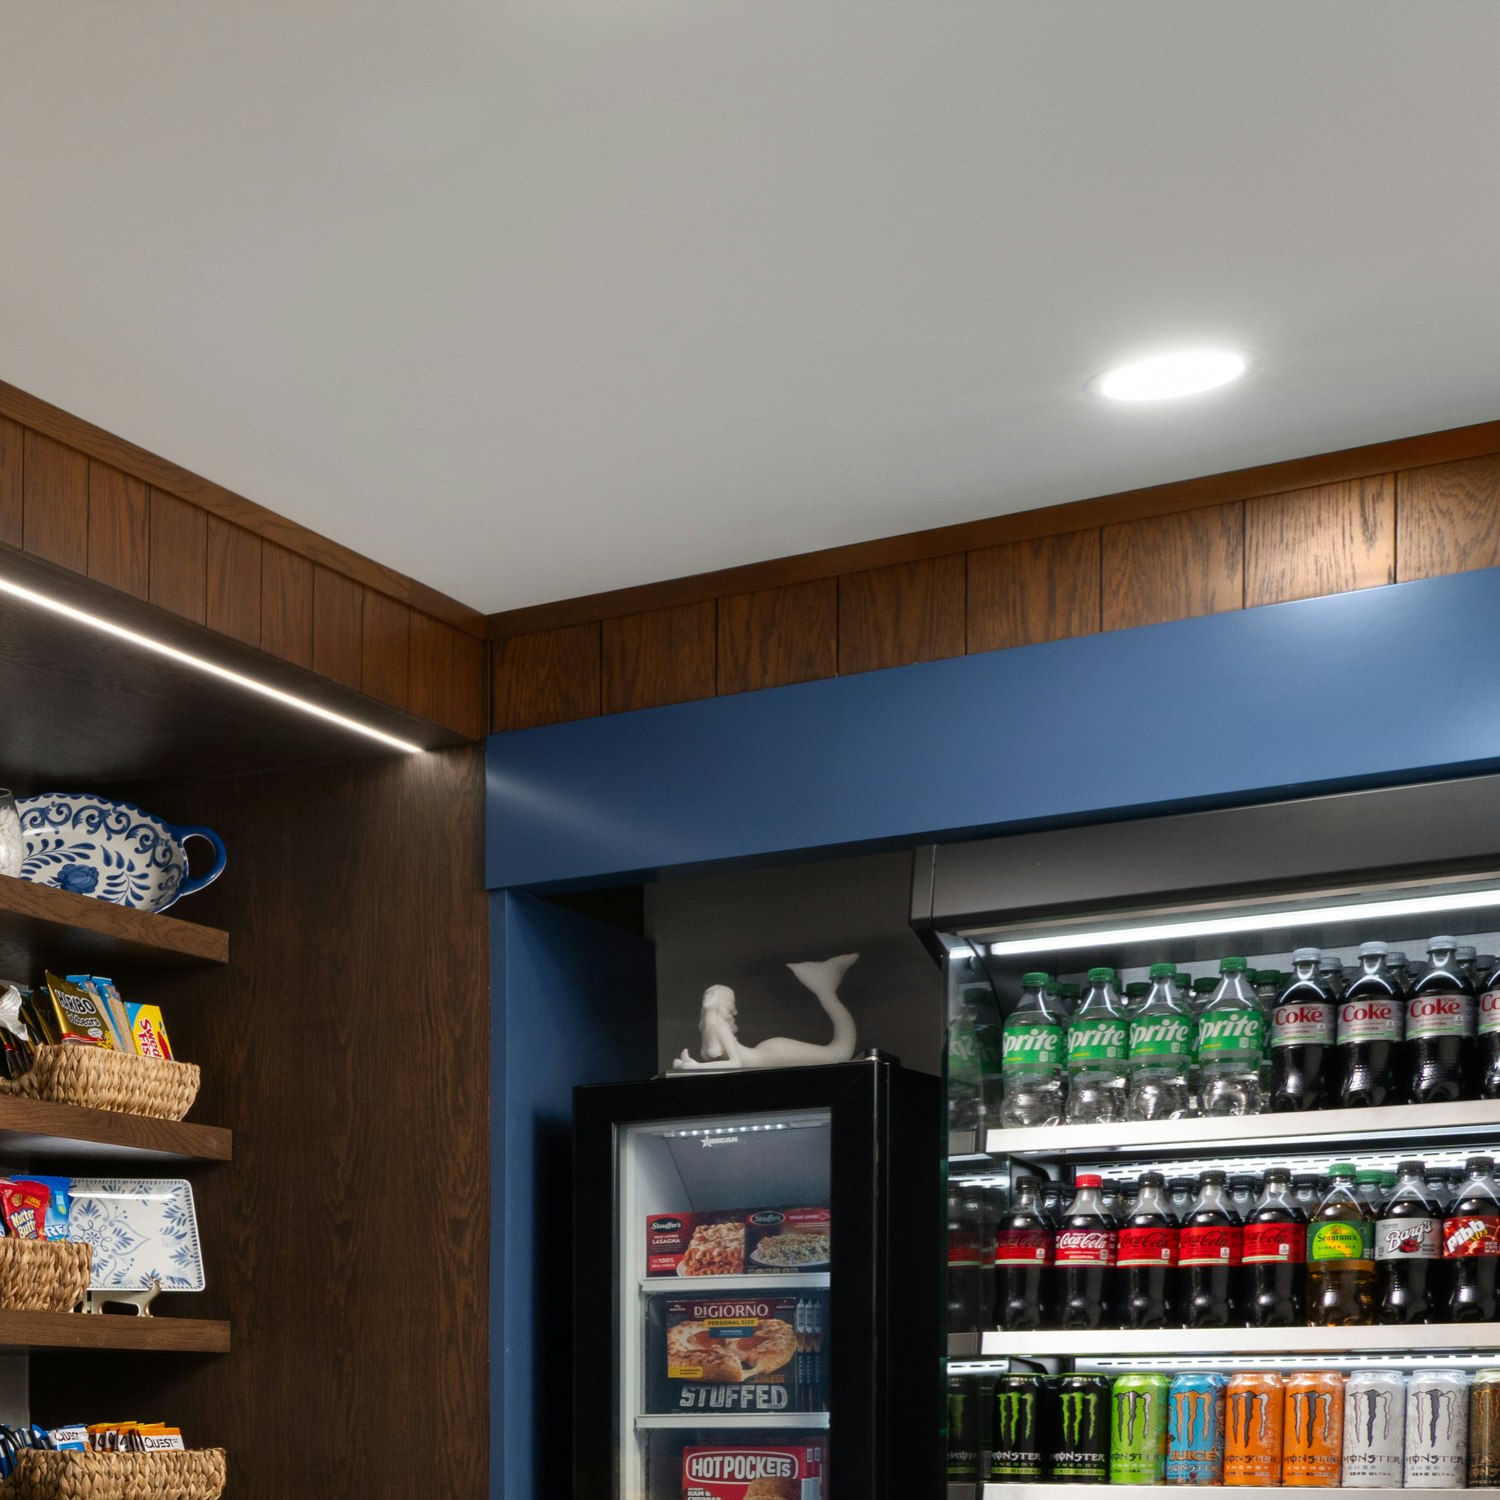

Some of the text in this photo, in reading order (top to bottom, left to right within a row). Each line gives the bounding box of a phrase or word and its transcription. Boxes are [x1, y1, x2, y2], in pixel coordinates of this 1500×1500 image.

[54, 989, 96, 1014] HARIBO
[1410, 998, 1460, 1018] Coke
[1275, 1007, 1322, 1026] Coke
[1342, 1003, 1392, 1022] Coke
[651, 1221, 681, 1230] Stouffer's
[755, 1214, 780, 1222] Stouffer's
[1060, 1231, 1108, 1249] Coca-Cola
[1317, 1234, 1357, 1242] Seagram's
[1385, 1219, 1433, 1253] Barq's
[1447, 1219, 1486, 1253] Pibb
[680, 1385, 788, 1409] STUFFED
[54, 1429, 79, 1441] QUEST
[144, 1435, 175, 1449] QUEST
[1054, 1452, 1105, 1462] MONSTER
[1169, 1450, 1216, 1461] JUICE
[692, 1456, 792, 1479] HOT POCKETS
